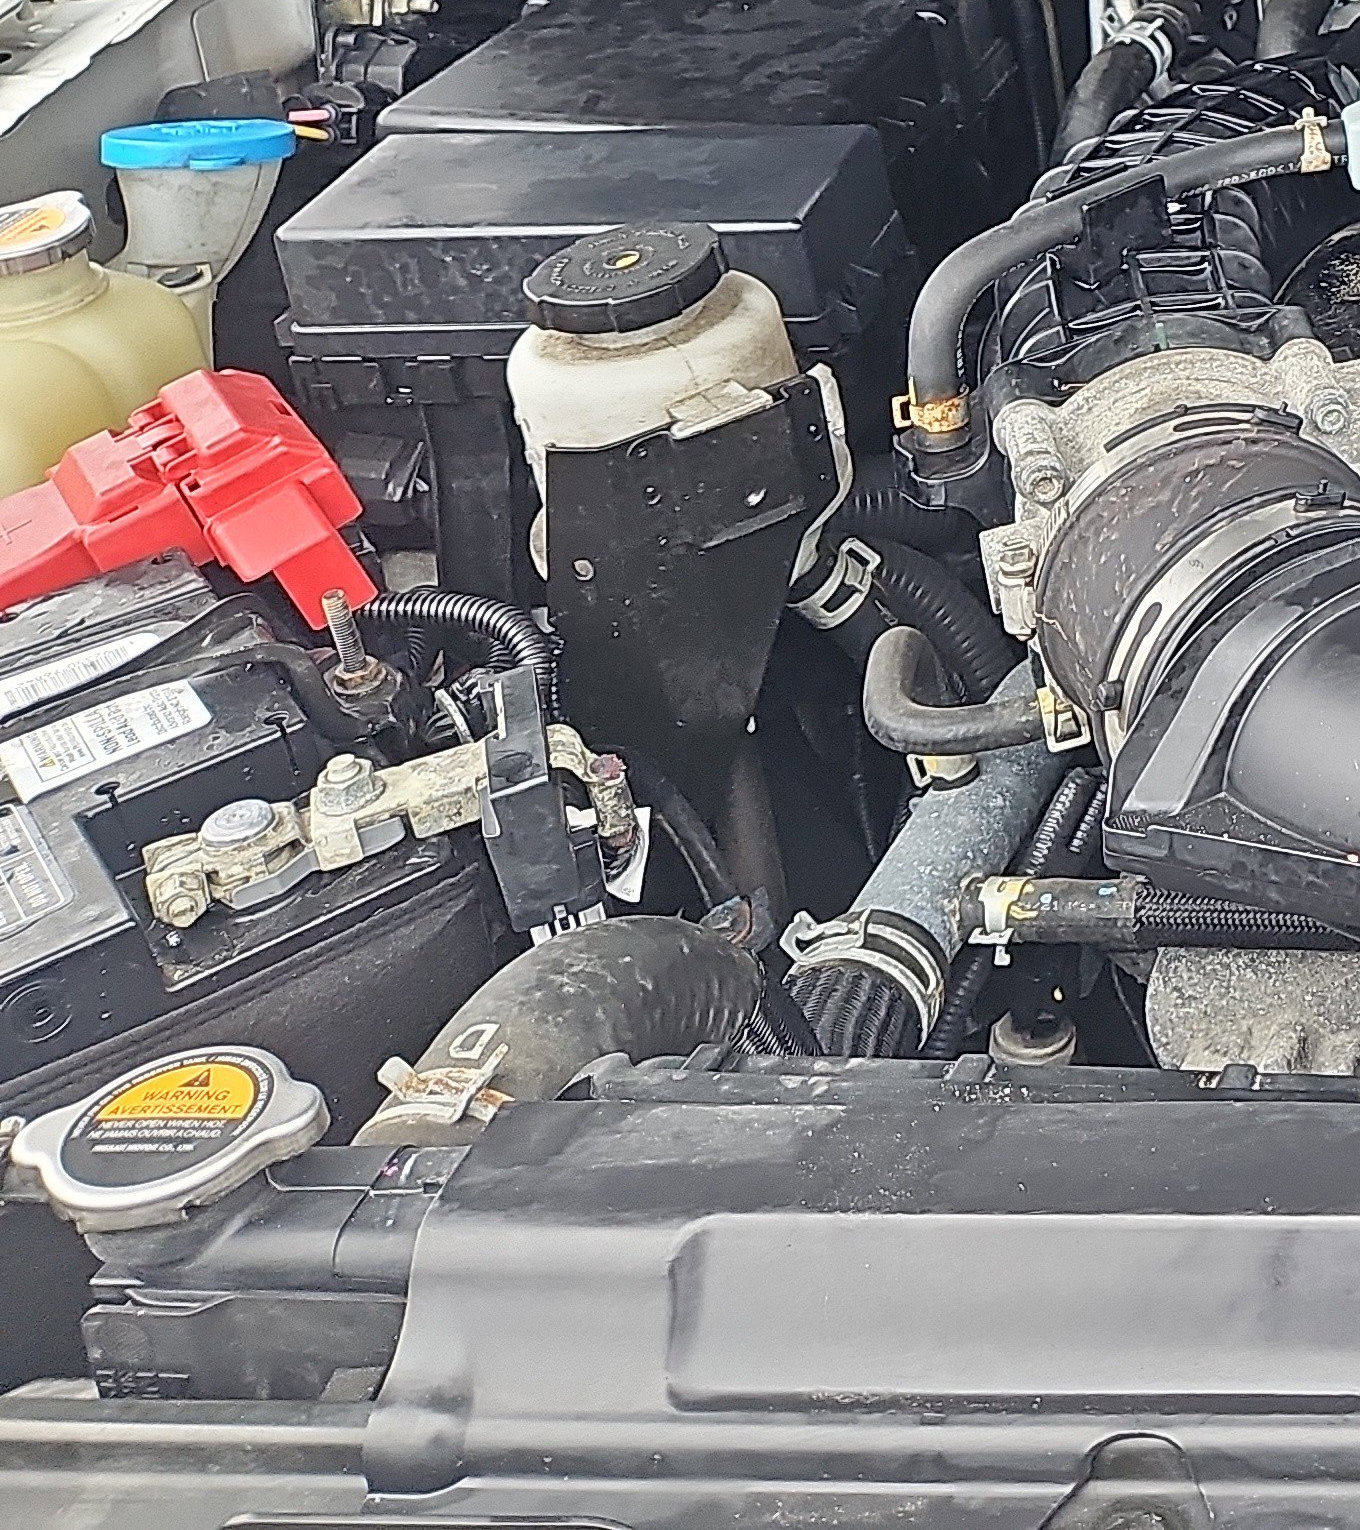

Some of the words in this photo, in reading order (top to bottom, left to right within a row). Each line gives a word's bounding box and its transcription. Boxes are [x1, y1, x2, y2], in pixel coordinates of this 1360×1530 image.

[143, 1090, 231, 1101] WARNING
[107, 1104, 243, 1115] AVERTISSEMENT
[98, 1120, 135, 1128] NEVER
[134, 1120, 168, 1128] OPEN
[167, 1120, 201, 1128] WHEN
